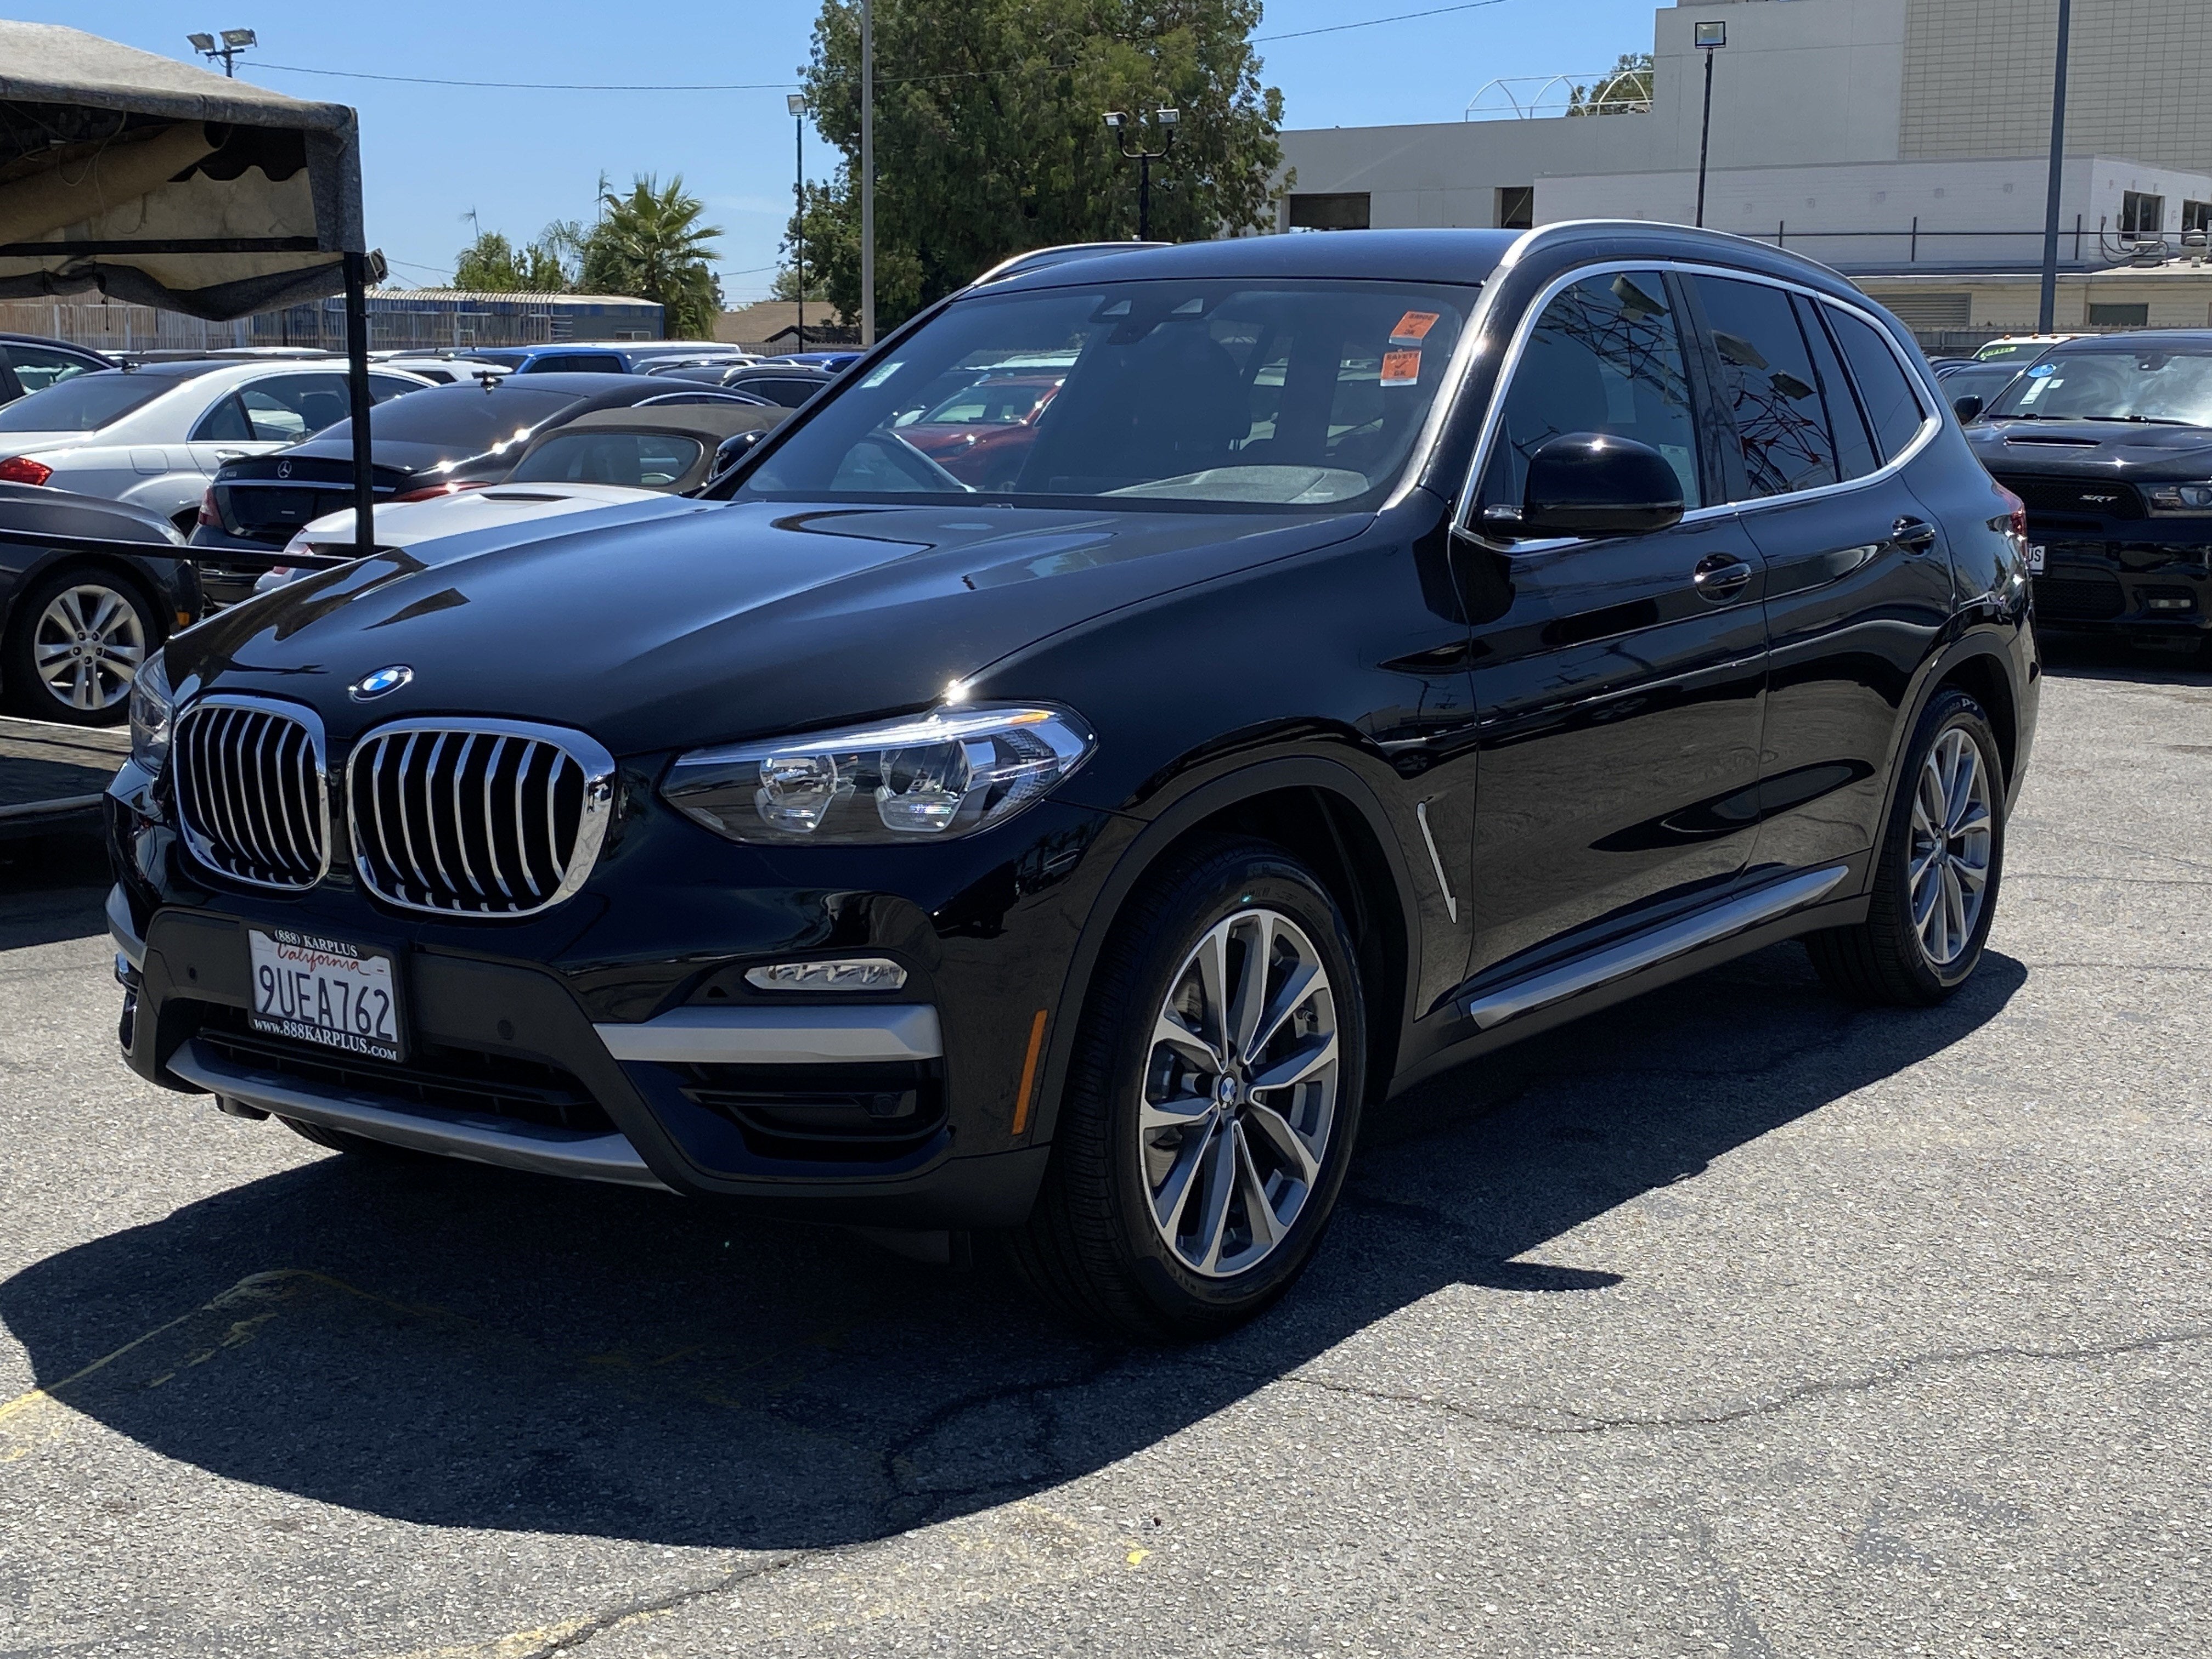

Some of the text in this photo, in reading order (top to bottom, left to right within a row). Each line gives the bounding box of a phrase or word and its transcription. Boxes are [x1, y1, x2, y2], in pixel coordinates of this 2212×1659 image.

[274, 929, 358, 957] (888) KARPLUS
[277, 943, 371, 976] California
[259, 964, 392, 1040] 9UEA762
